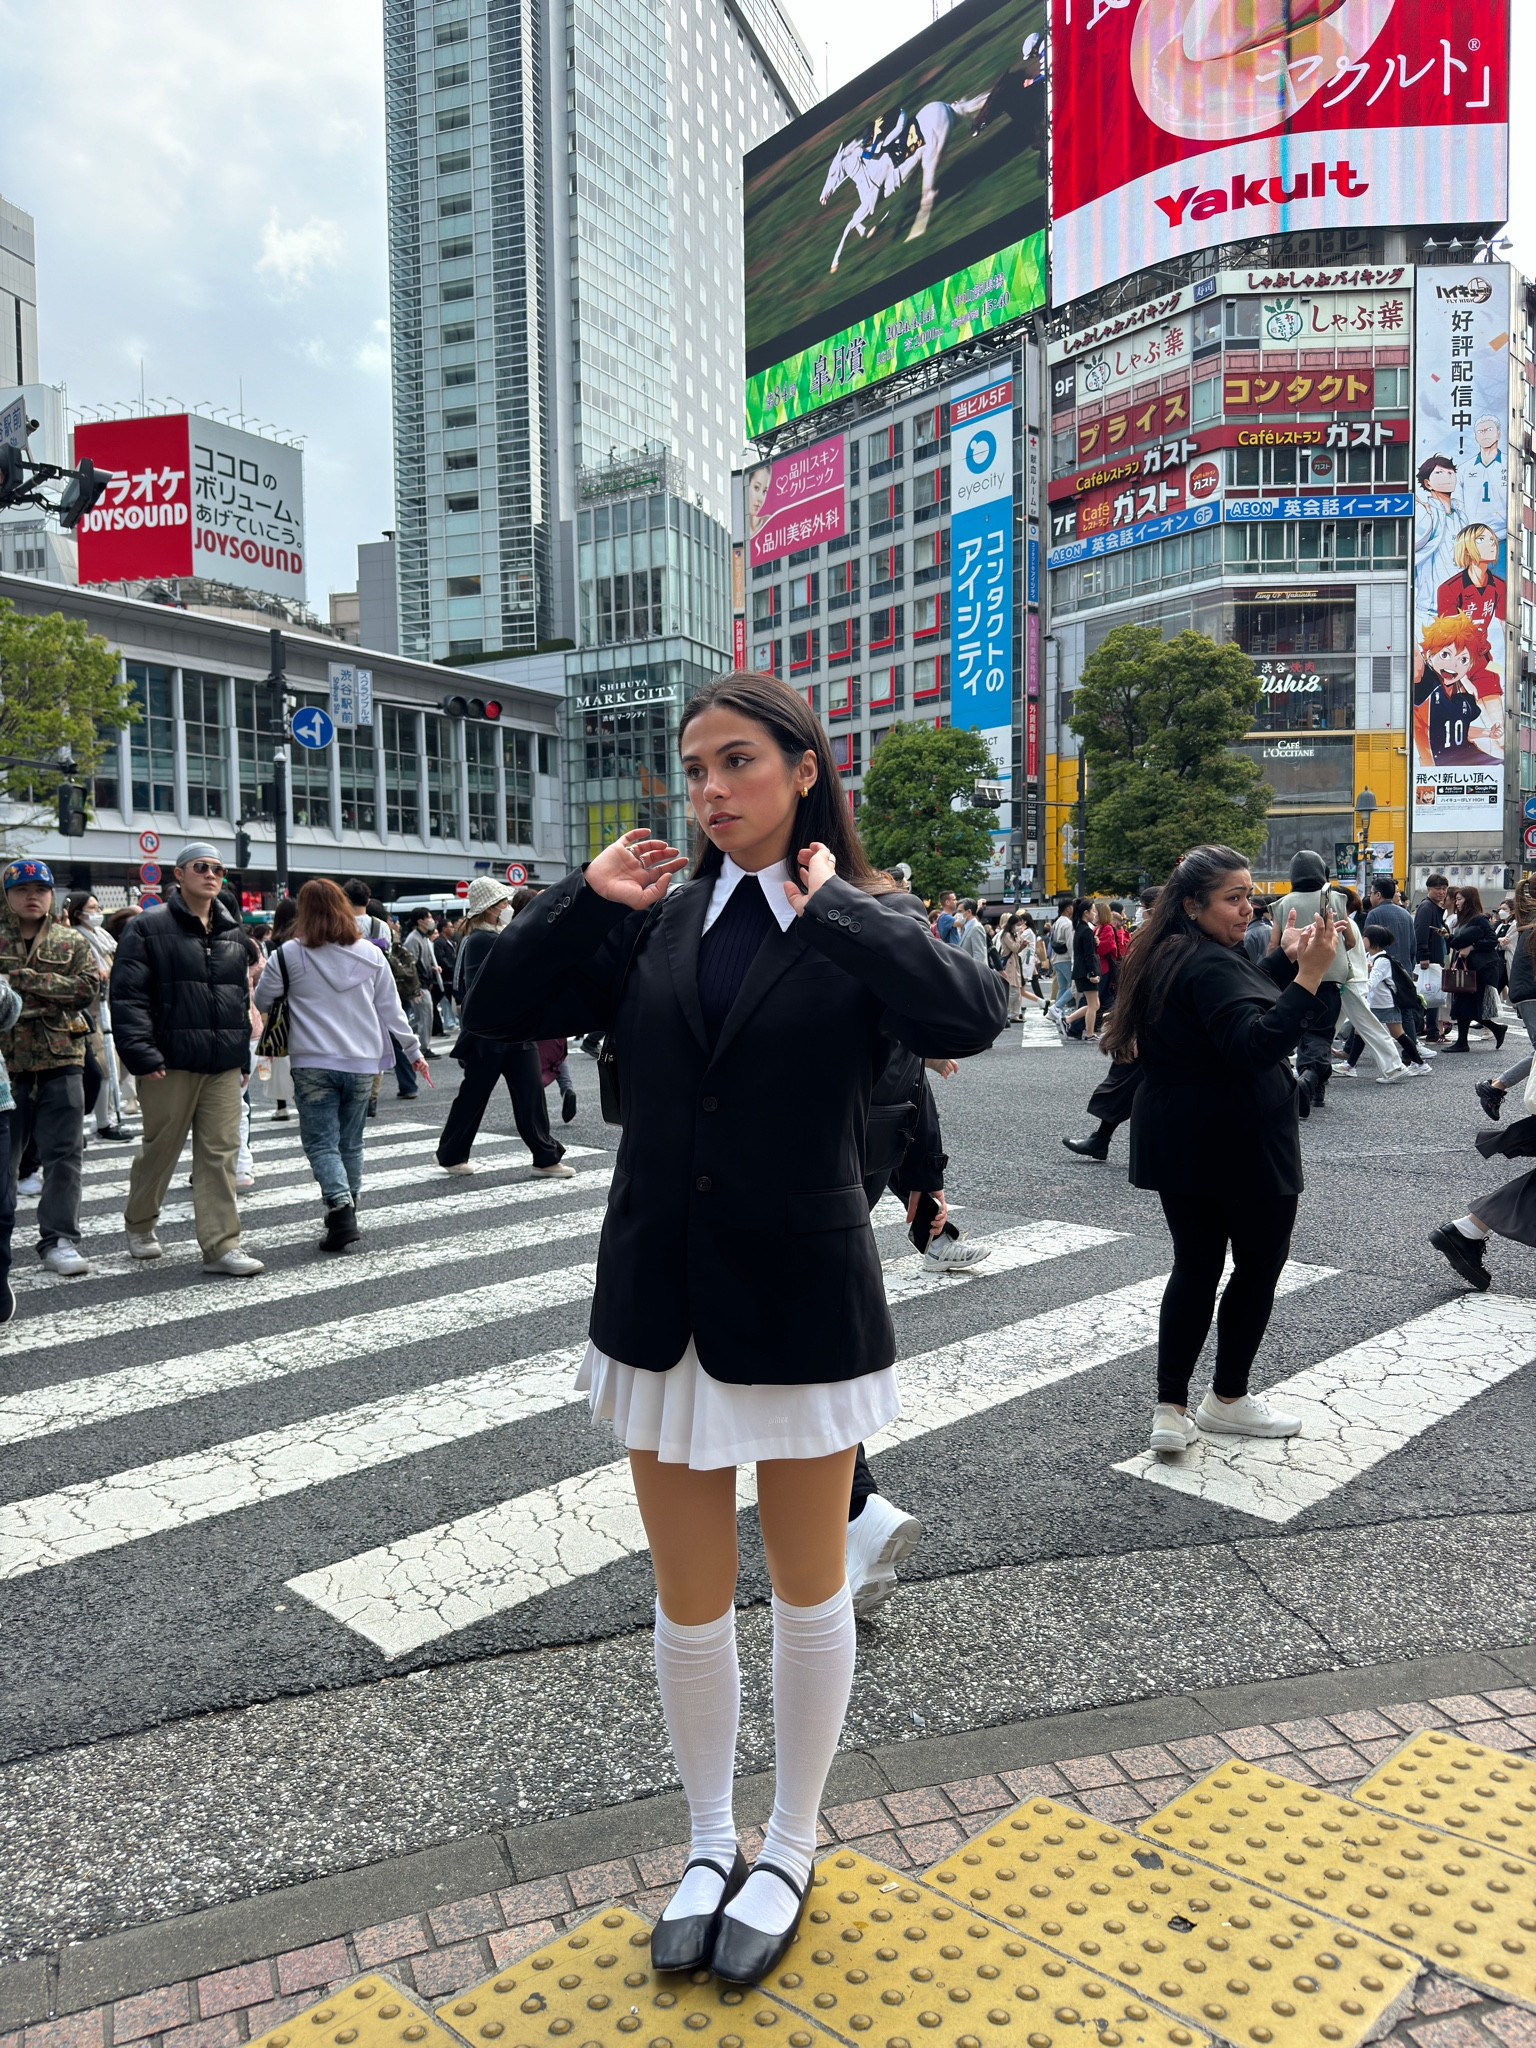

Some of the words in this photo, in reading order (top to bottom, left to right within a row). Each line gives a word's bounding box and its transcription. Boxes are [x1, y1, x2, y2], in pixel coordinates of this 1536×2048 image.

[1154, 161, 1369, 228] Yakult
[1248, 267, 1405, 289] しゃぶしゃぶバイキング
[1063, 292, 1182, 354] しゃぶしゃぶバイキング
[1312, 300, 1404, 332] しゃぶ葉
[809, 336, 867, 397] 皐月賞
[1115, 328, 1184, 375] しゃぶ葉
[1055, 376, 1074, 397] 9F
[1225, 374, 1368, 403] コンタクト
[1451, 310, 1474, 455] 好評配信中!
[957, 386, 1006, 419] 当ビル5F
[1080, 394, 1187, 453] プライス
[1326, 422, 1394, 447] ガスト
[195, 444, 277, 491] ココロの
[788, 448, 839, 480] 品川スキン
[1143, 438, 1197, 475] ガスト
[789, 467, 834, 498] クリニック
[958, 472, 1005, 500] eyecity
[1193, 477, 1216, 490] ガスト
[1482, 481, 1491, 503] 1
[195, 476, 300, 527] ボリューム、
[1082, 502, 1110, 521] Café
[1113, 481, 1179, 527] ガスト
[1232, 502, 1272, 515] AEON
[82, 503, 188, 532] JOYSOUND
[196, 504, 302, 548] あげていこう。
[763, 507, 839, 554] 品川美容外科
[1053, 512, 1076, 536] 7F
[1083, 517, 1110, 532] レストラン
[1052, 544, 1082, 563] AEON
[1195, 508, 1212, 523] 6F
[194, 528, 303, 575] JOYSOUND
[957, 536, 983, 696] アイシティ
[986, 529, 1004, 692] コンタクトの
[341, 669, 353, 724] 渋谷駅前
[576, 692, 626, 709] MARK
[634, 685, 677, 700] CITY
[600, 679, 648, 692] SHIBUYA
[1257, 674, 1321, 694] Ushi8
[1444, 720, 1463, 748] 10
[1263, 748, 1315, 758] L'OCCITANE
[1416, 772, 1498, 784] 飛べ!新しい頂へ。
[1253, 881, 1277, 894] NE
